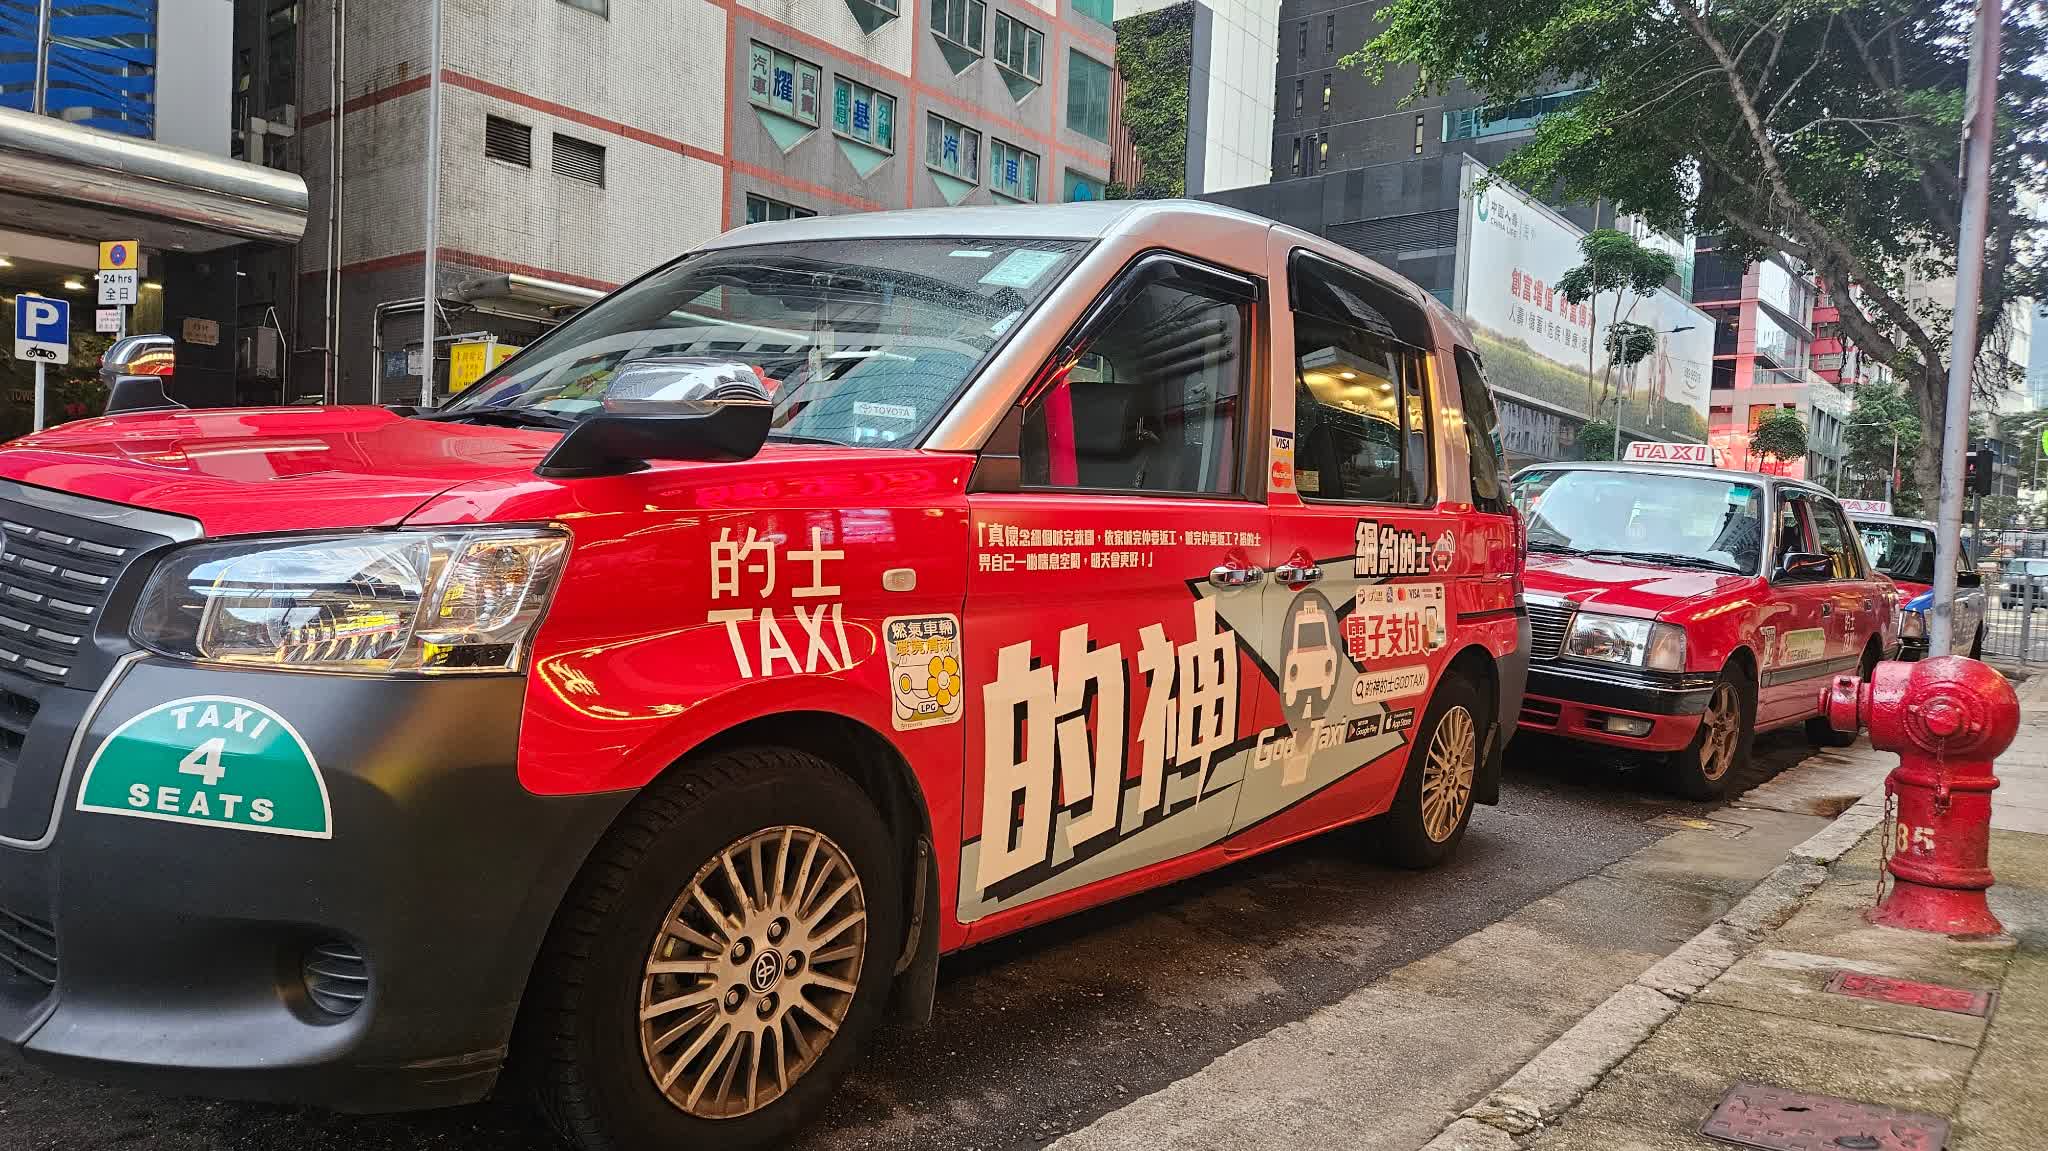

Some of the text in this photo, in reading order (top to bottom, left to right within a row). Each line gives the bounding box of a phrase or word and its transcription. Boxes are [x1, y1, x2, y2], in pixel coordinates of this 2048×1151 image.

[752, 54, 768, 95] 汽車
[773, 67, 793, 102] 耀
[854, 100, 870, 131] 基
[944, 135, 959, 164] 汽
[1006, 160, 1018, 185] 車
[103, 273, 133, 285] 24 hrs
[105, 287, 130, 301] 全日
[26, 301, 60, 338] P
[873, 405, 910, 417] TOYOTA
[1276, 438, 1290, 449] VISA
[1632, 443, 1707, 461] TAXI
[1840, 500, 1886, 512] TAXI
[710, 527, 844, 599] 的士
[1356, 521, 1431, 576] 網約的士
[1409, 588, 1421, 599] VISA
[707, 602, 853, 679] TAXI
[891, 620, 954, 639] 燃氣車輛
[1348, 611, 1420, 659] 電子支付
[170, 704, 271, 740] TAXI
[921, 702, 936, 713] LPG
[1400, 718, 1412, 727] Store
[975, 594, 1238, 892] 的神
[1310, 716, 1348, 755] Taxi
[1355, 726, 1370, 737] Google
[178, 737, 226, 786] 4
[127, 783, 274, 823] SEATS
